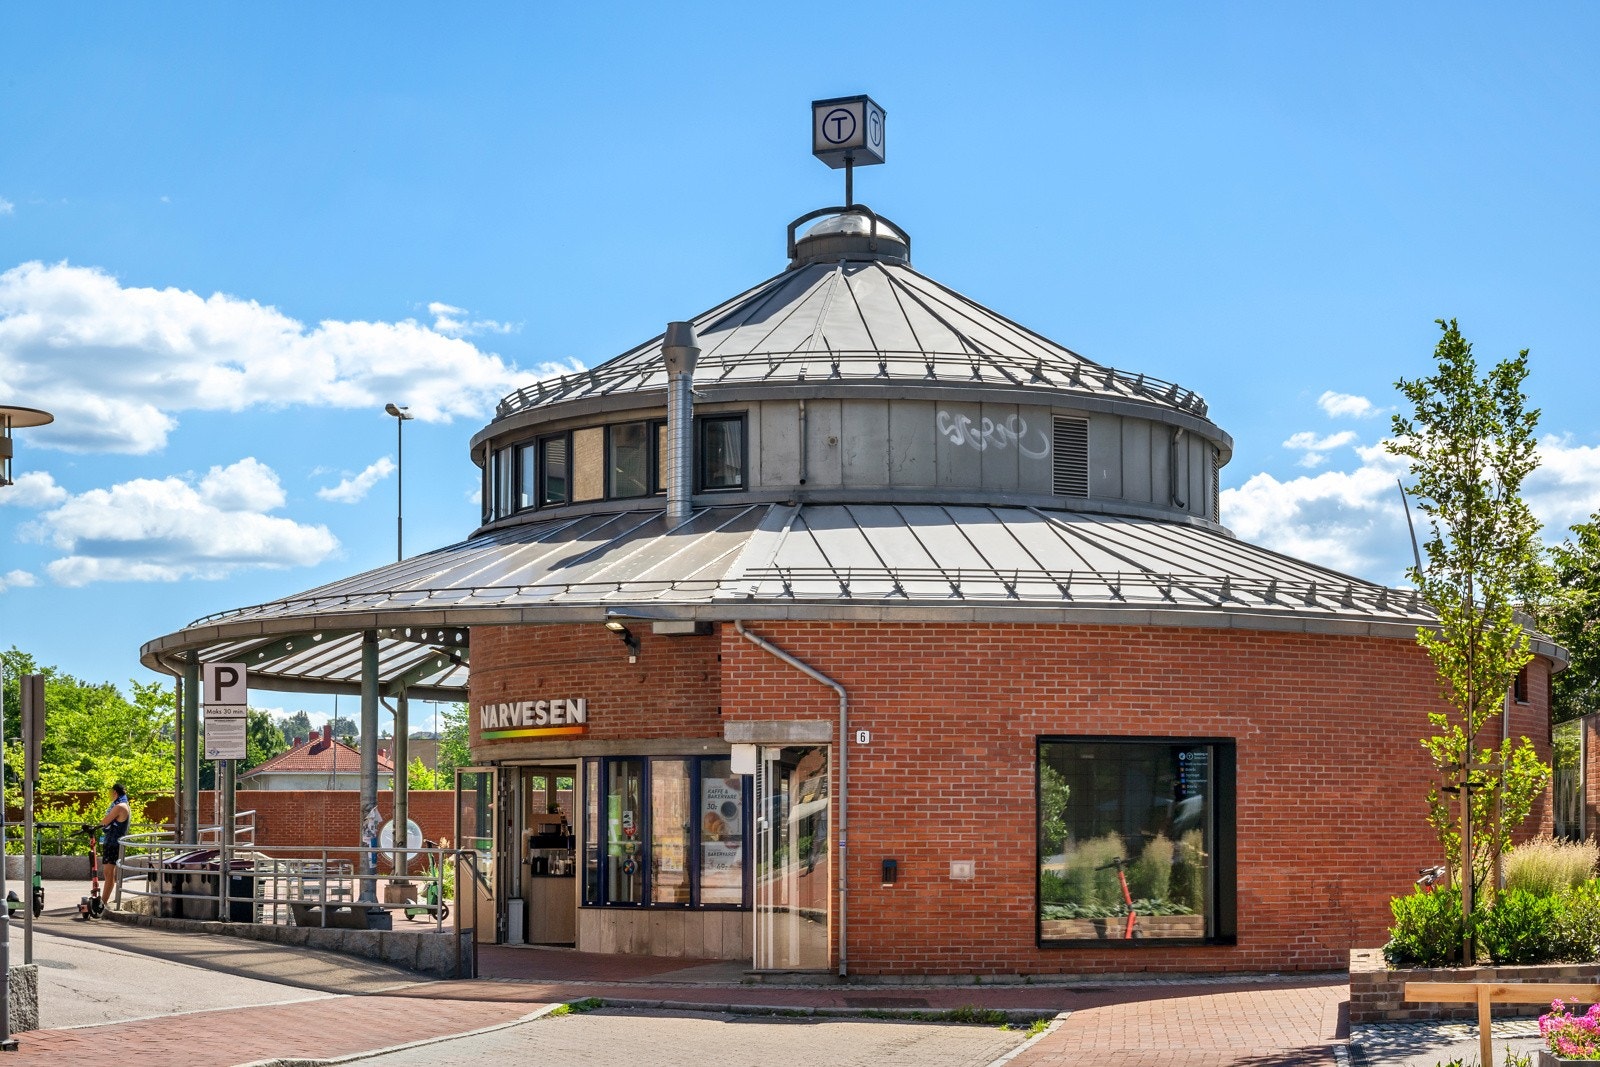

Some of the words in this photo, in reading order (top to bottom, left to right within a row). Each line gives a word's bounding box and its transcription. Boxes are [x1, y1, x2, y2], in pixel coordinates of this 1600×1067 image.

[831, 116, 848, 140] T
[214, 666, 239, 702] P
[480, 698, 586, 729] NARVESEN
[860, 732, 866, 742] 6
